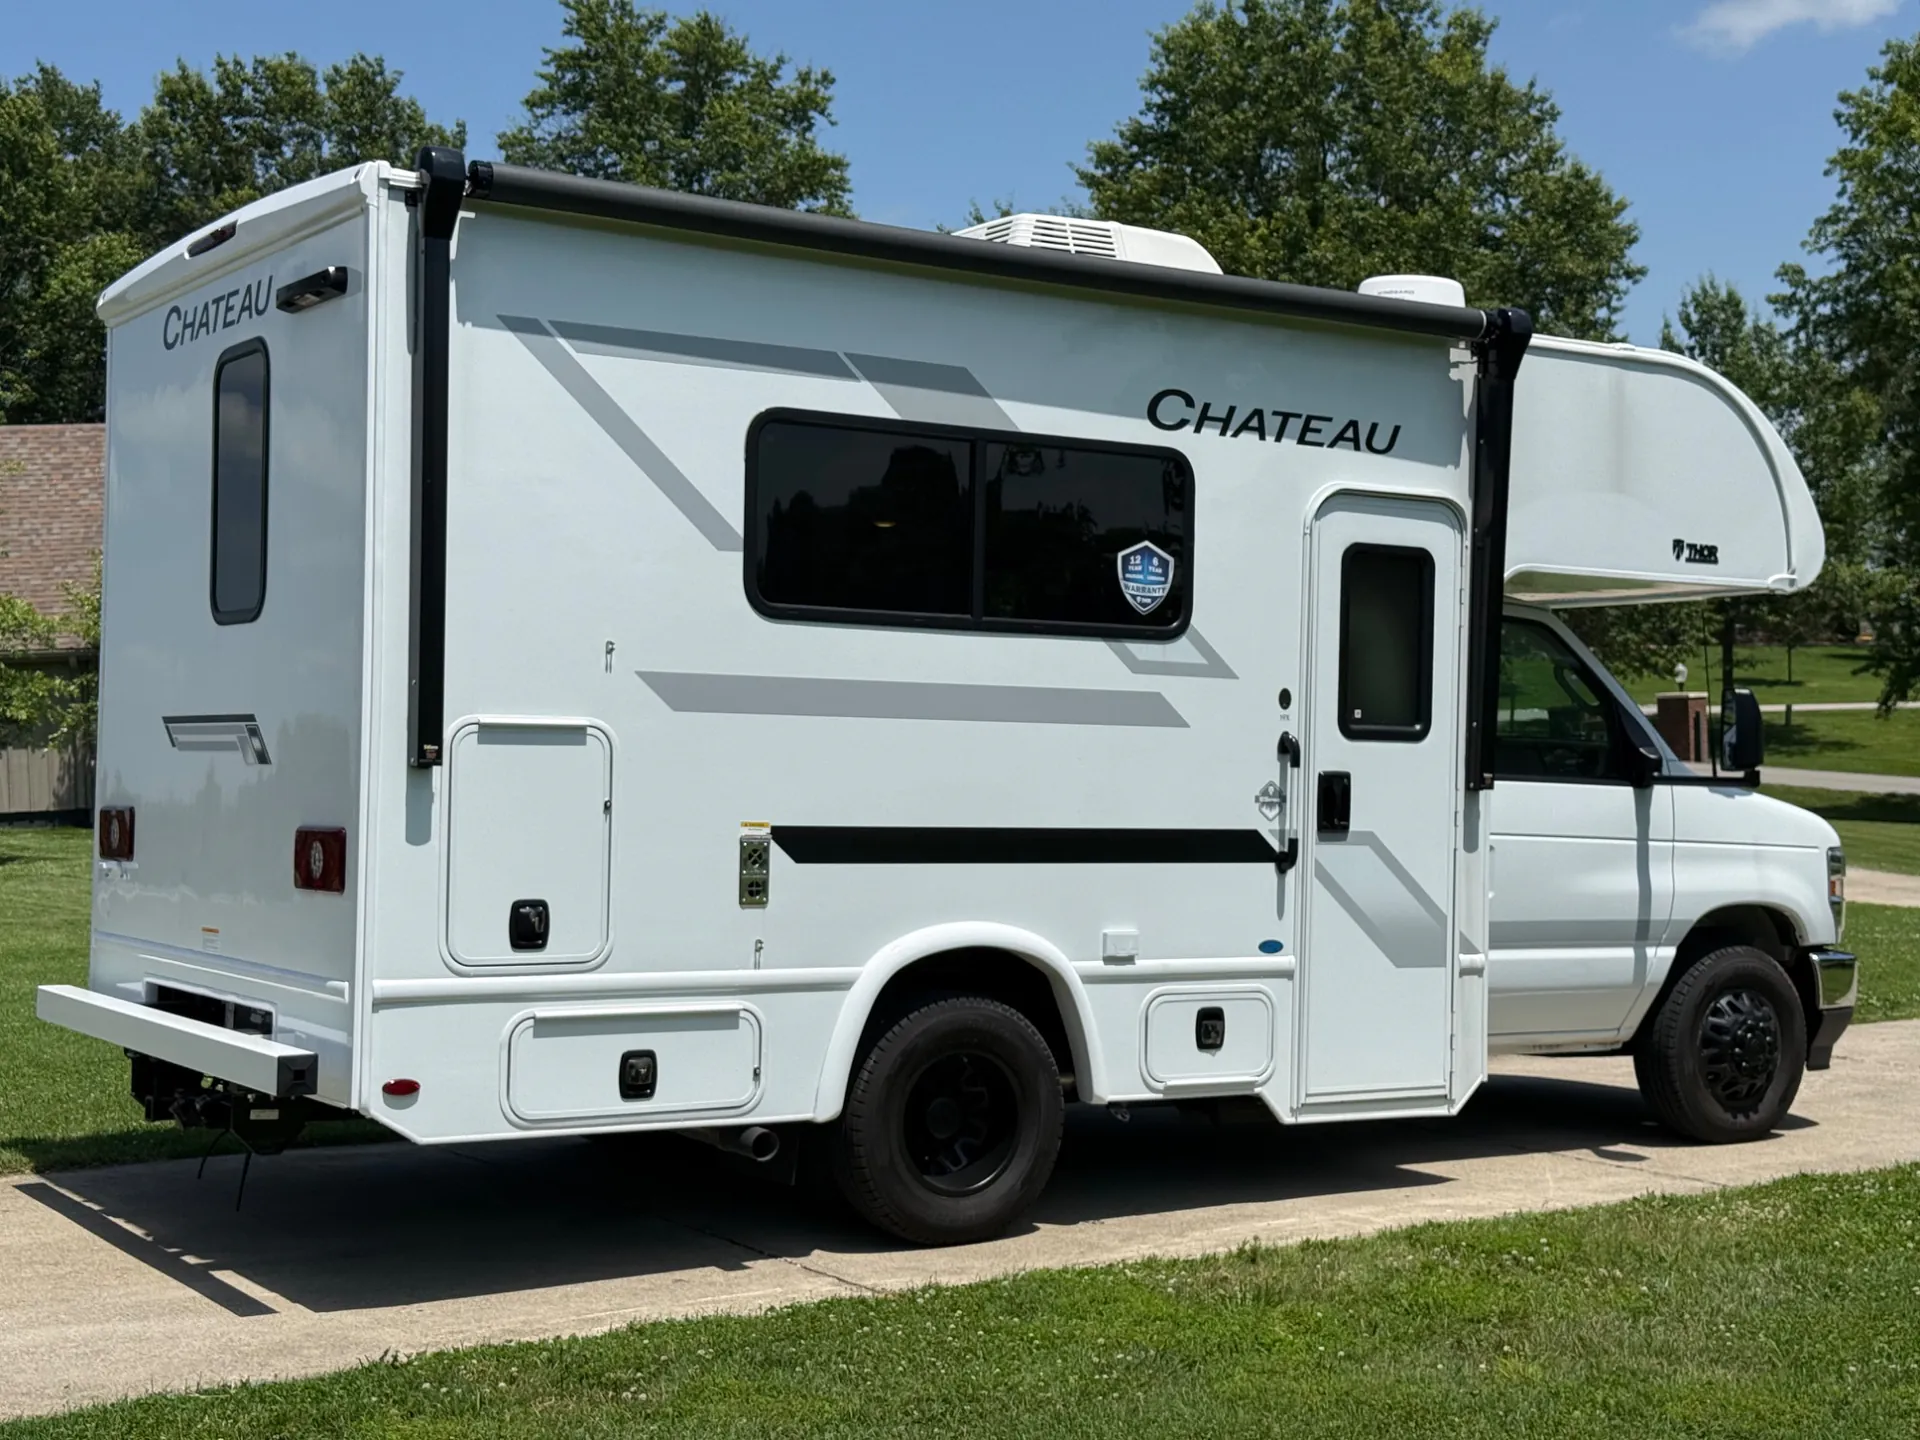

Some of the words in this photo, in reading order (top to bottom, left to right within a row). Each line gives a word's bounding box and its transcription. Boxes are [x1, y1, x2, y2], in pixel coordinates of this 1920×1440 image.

[163, 275, 273, 351] CHATEAU
[1147, 388, 1402, 455] CHATEAU
[1129, 555, 1141, 565] 12
[1686, 543, 1718, 560] THOR
